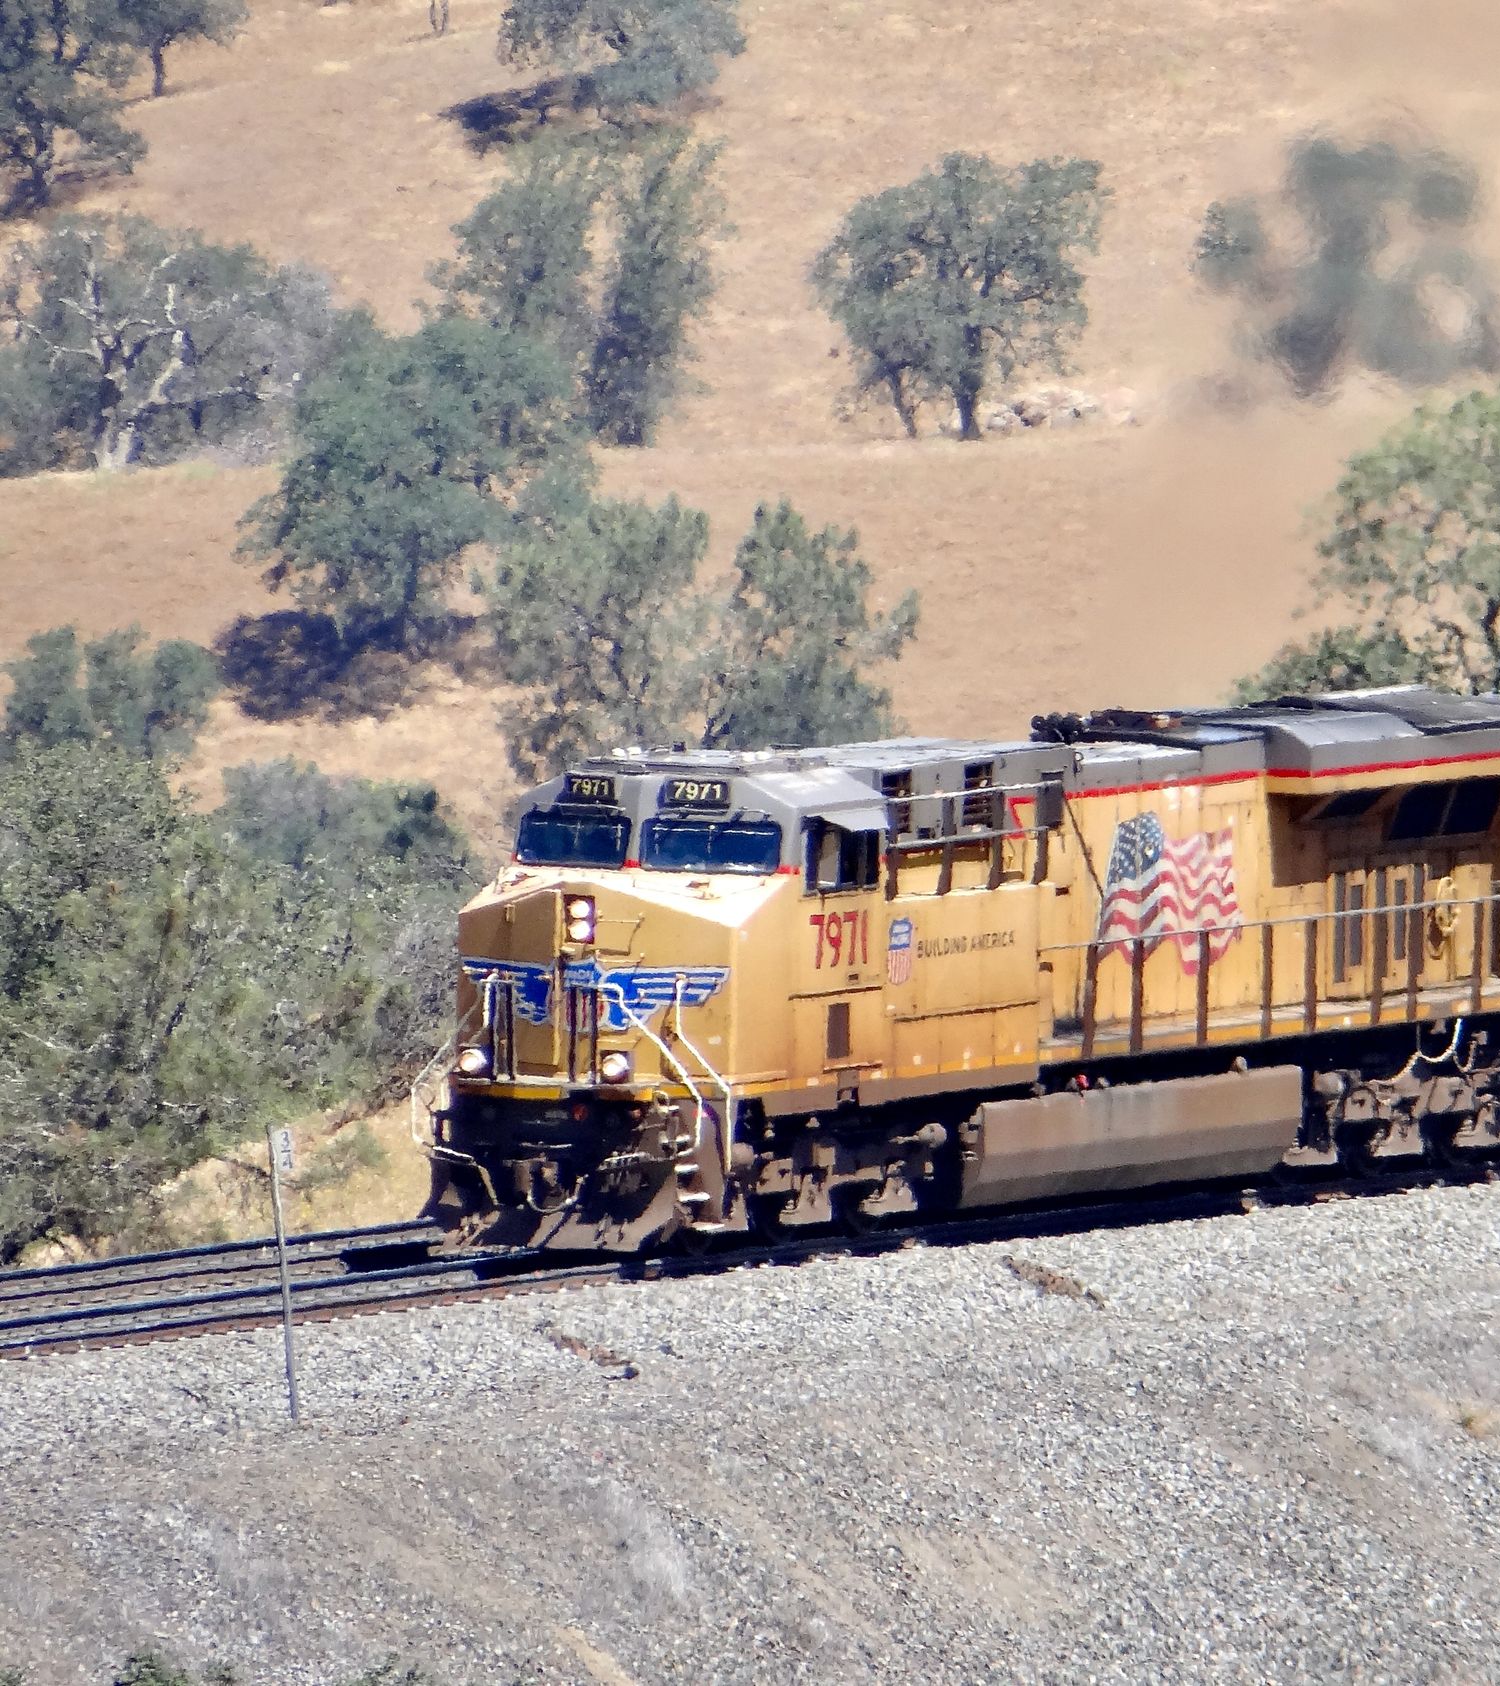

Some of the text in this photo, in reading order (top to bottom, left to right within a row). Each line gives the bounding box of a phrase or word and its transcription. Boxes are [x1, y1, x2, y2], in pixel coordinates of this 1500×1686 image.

[570, 778, 609, 796] 7971
[673, 781, 721, 800] 7971
[809, 909, 868, 969] 7971
[917, 930, 1015, 959] BUILDING AMERICA
